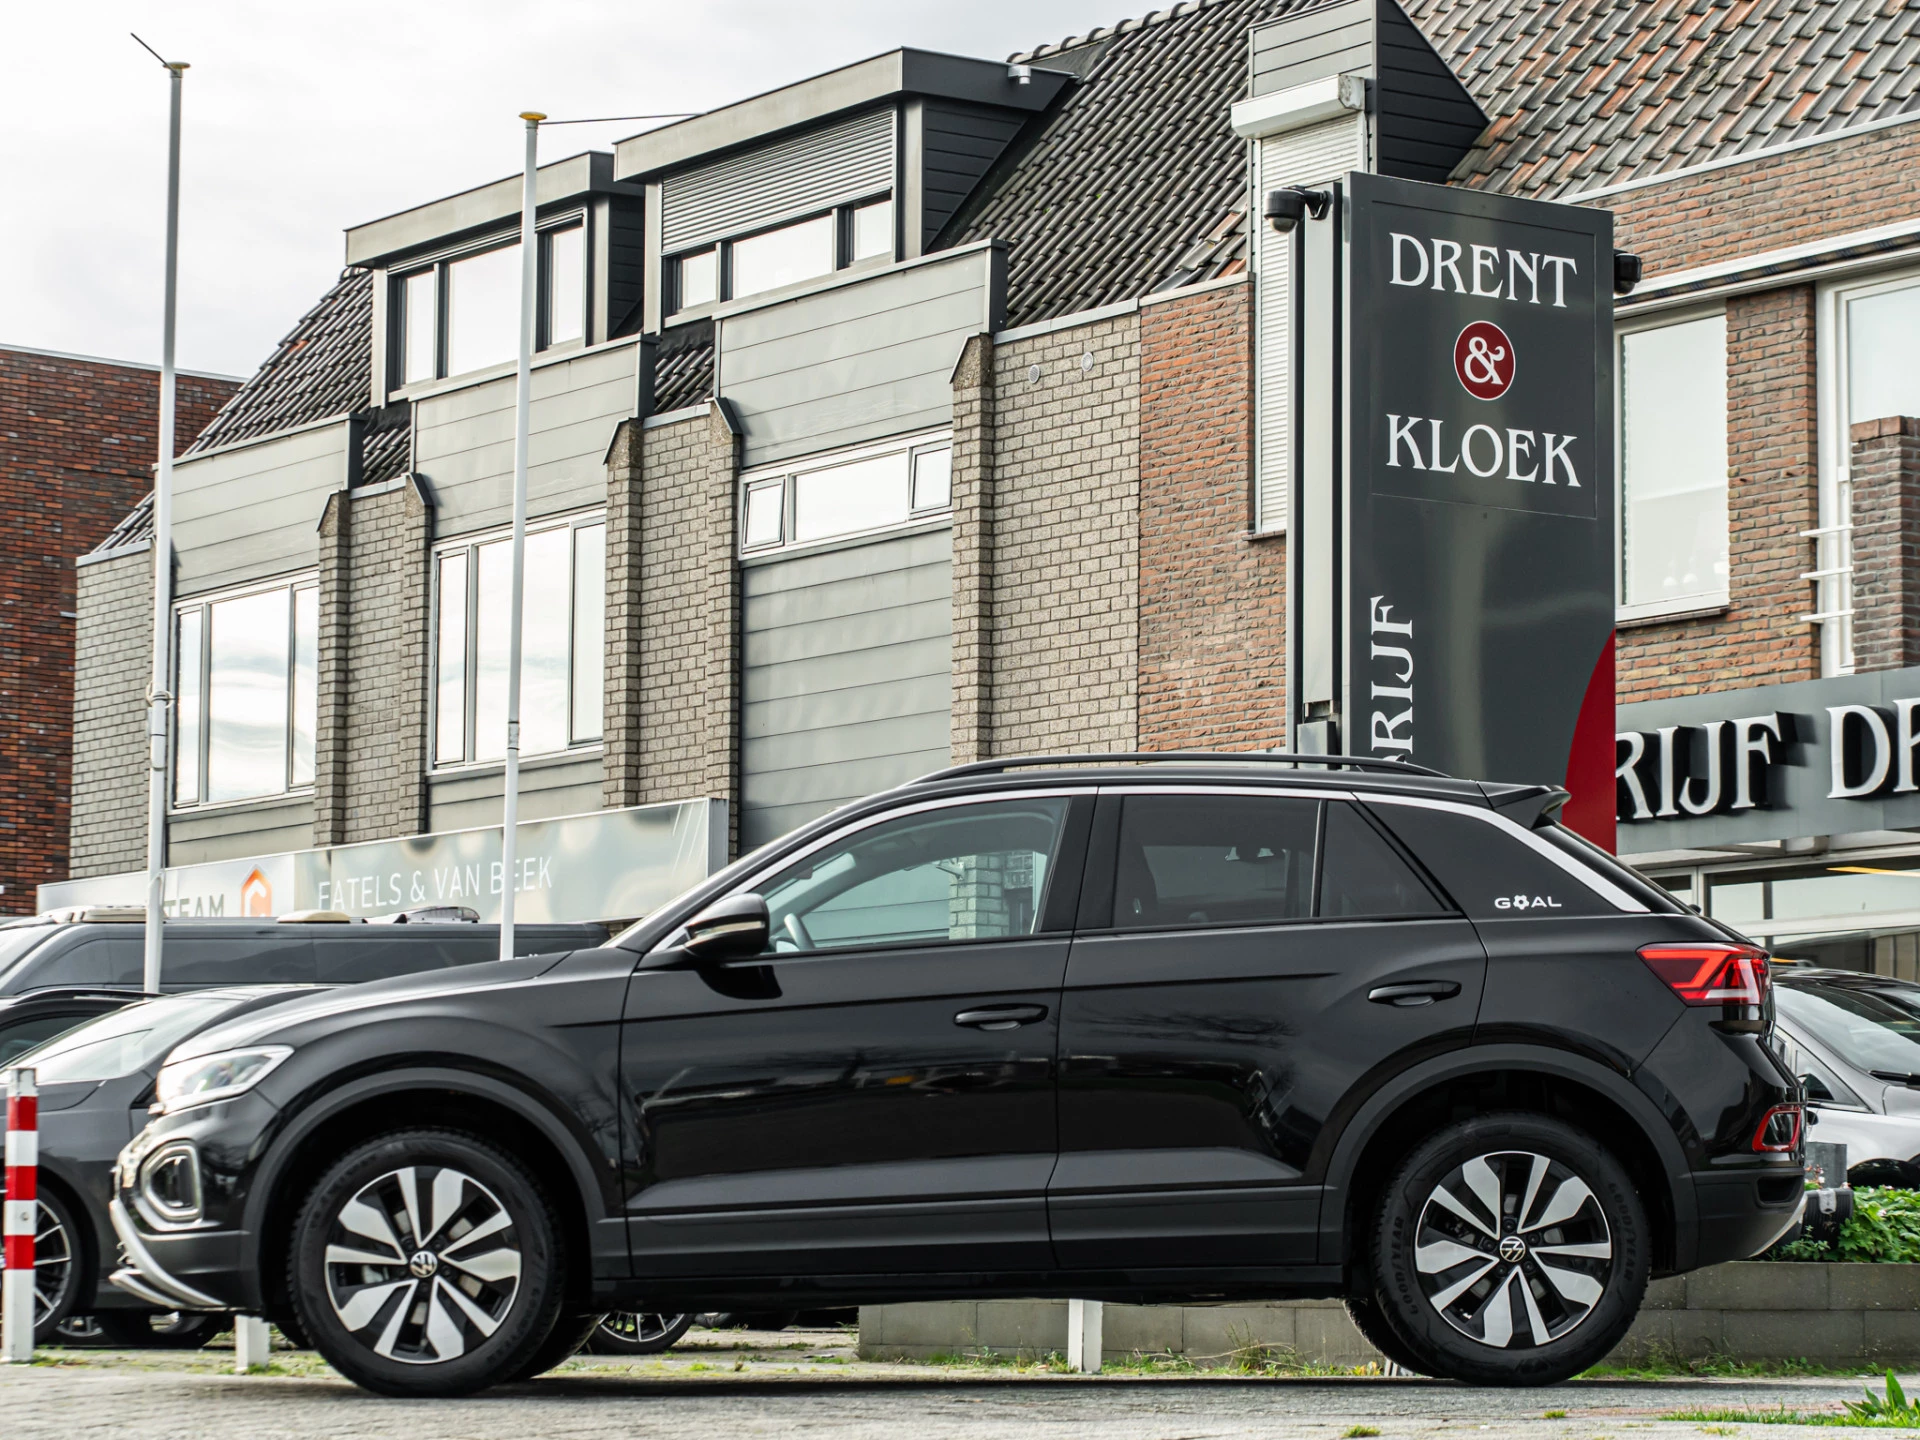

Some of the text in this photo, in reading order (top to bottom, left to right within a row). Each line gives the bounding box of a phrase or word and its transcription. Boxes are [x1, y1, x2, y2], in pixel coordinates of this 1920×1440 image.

[1389, 232, 1578, 308] DRENT
[1463, 336, 1506, 386] &
[1386, 413, 1582, 488] KLOEK
[1369, 595, 1414, 763] RIJF
[410, 870, 427, 904] &
[434, 862, 481, 900] VAN
[1494, 895, 1562, 910] GOAL
